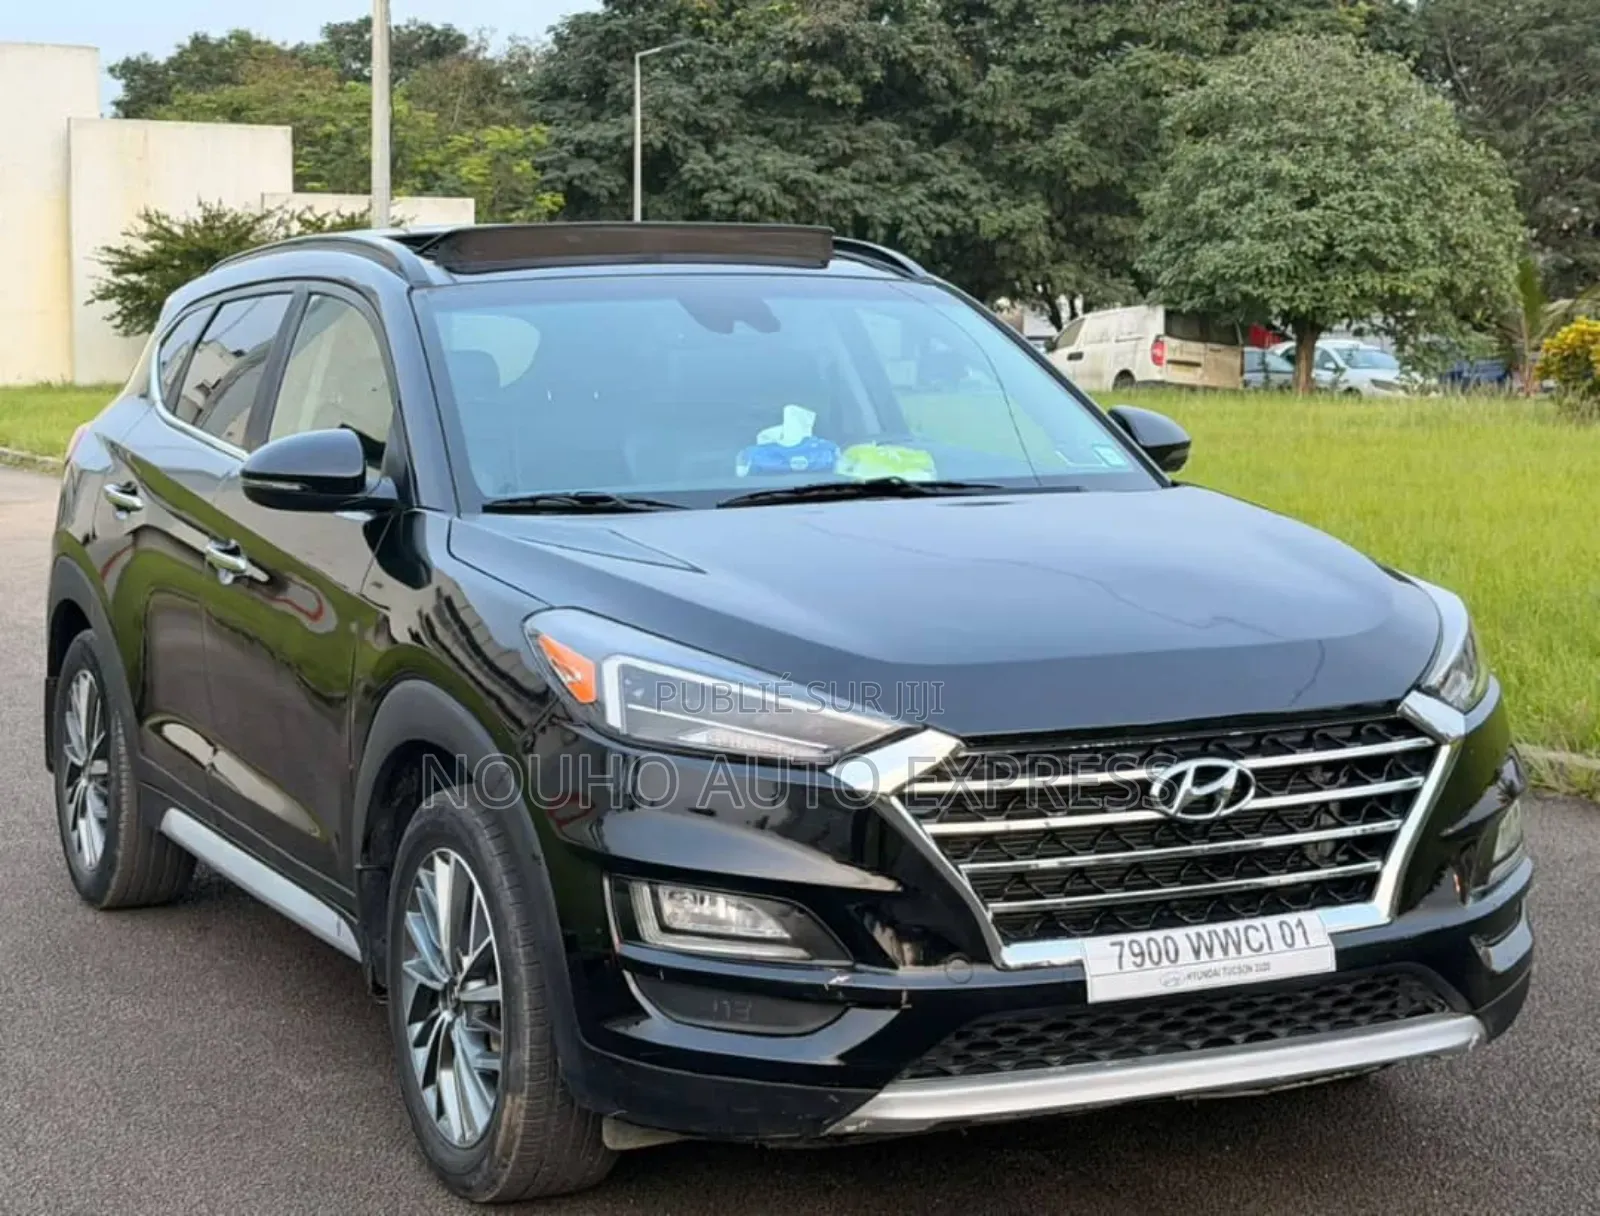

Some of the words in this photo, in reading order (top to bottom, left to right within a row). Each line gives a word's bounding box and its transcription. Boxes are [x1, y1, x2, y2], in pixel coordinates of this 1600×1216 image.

[1109, 934, 1180, 970] 7900
[1185, 923, 1274, 961] WWCI
[1278, 918, 1310, 949] 01
